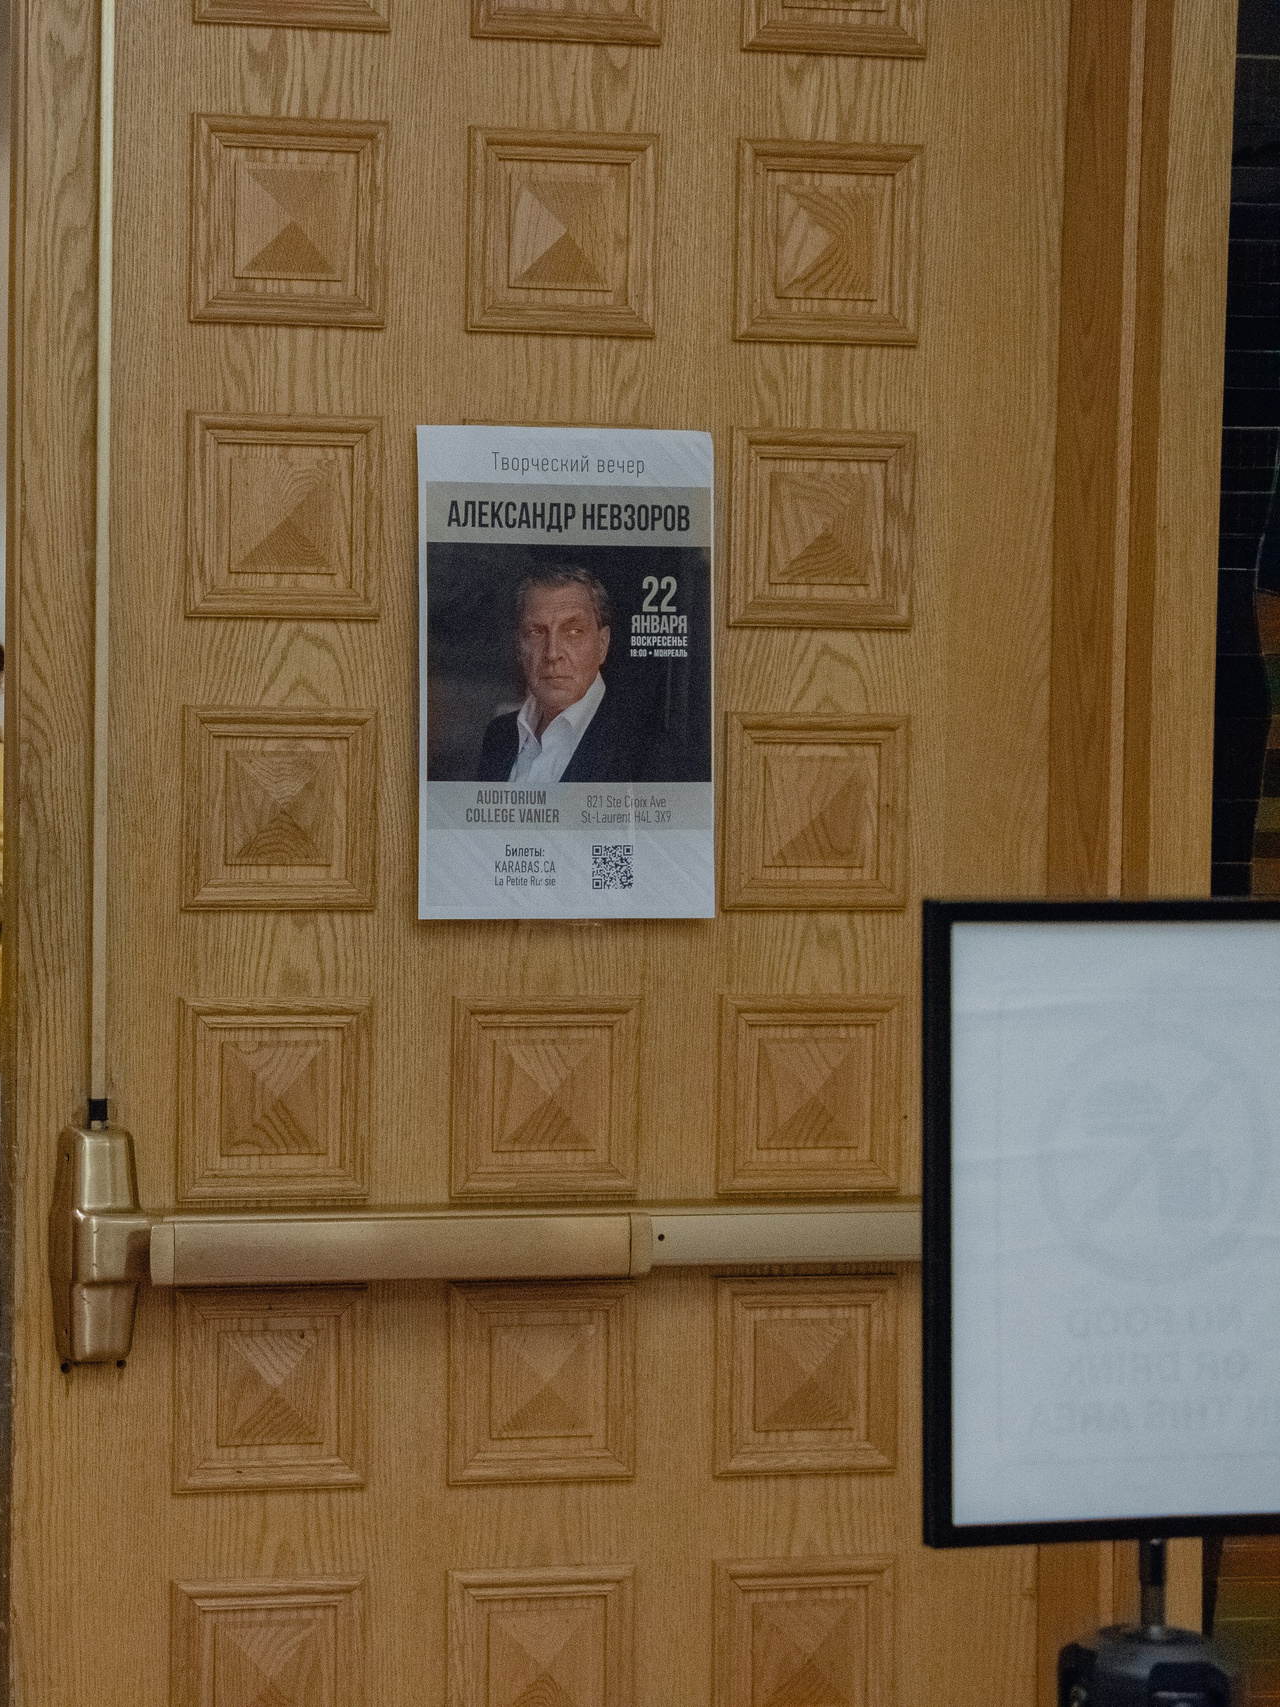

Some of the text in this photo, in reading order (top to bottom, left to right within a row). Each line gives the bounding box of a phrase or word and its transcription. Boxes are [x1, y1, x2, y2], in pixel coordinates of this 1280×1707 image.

[492, 452, 645, 478] Творческий вечер
[447, 500, 691, 533] АЛЕКСАНДР НЕВЗОРОВ
[642, 575, 678, 612] 22
[631, 614, 688, 634] ЯНВАРЯ
[630, 635, 688, 647] ВОСКРЕСЕНЬЕ
[476, 790, 547, 805] AUDITORIUM
[586, 795, 603, 808] 821
[606, 795, 622, 808] Ste
[649, 795, 667, 808] Ave
[465, 808, 560, 823] COLLEGE VANIER
[581, 810, 631, 823] St-Laurent
[505, 844, 545, 857] Билеты:
[494, 860, 556, 873] KARABAS.CA
[494, 875, 504, 886] La
[506, 875, 528, 886] Petite
